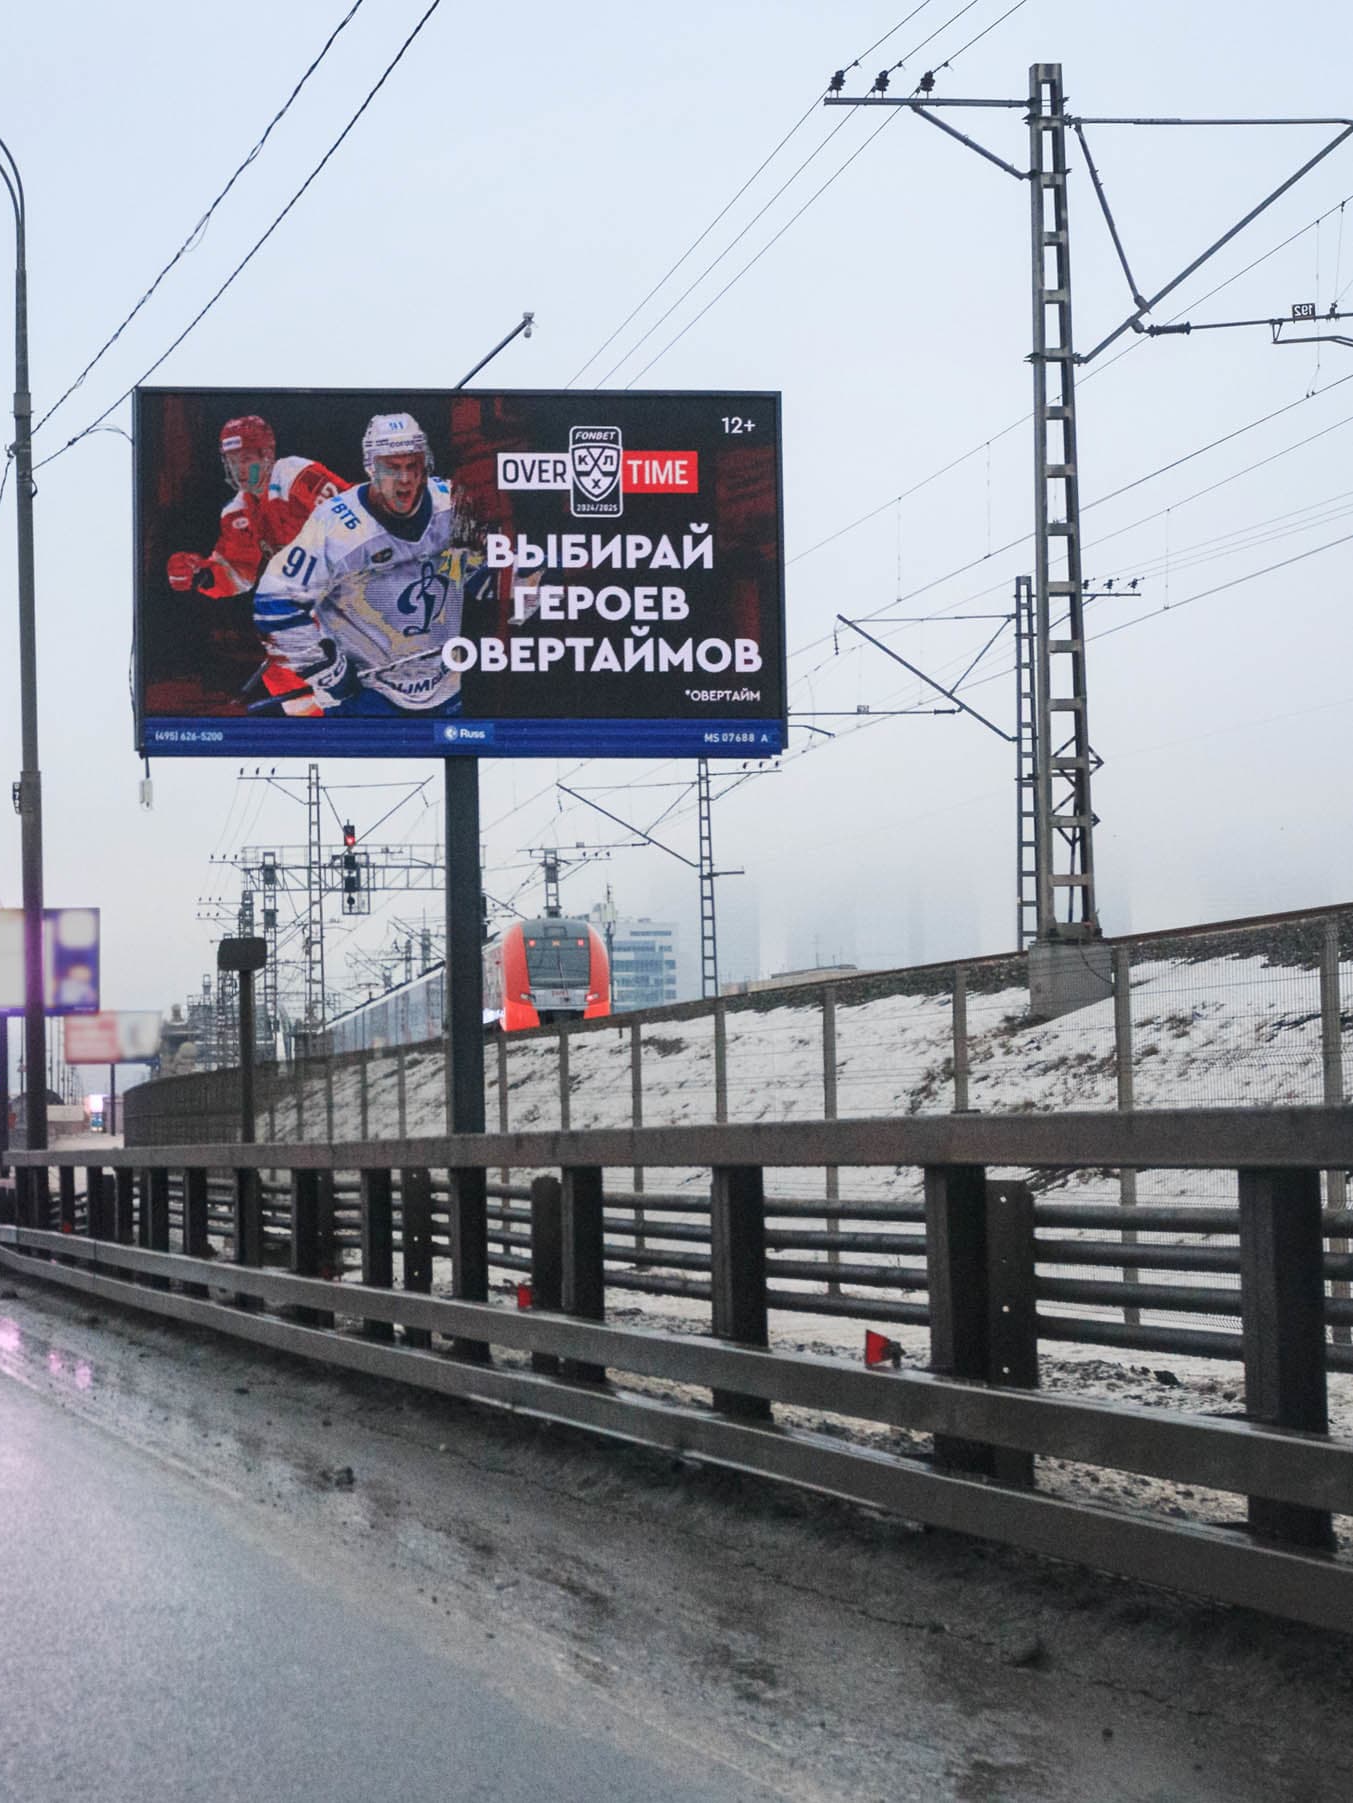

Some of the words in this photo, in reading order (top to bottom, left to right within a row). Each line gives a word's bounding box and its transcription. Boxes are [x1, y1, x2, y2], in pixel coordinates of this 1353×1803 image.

[575, 431, 616, 441] FONBET
[721, 416, 756, 434] 12+
[502, 459, 567, 484] OVER
[627, 460, 688, 485] TIME
[331, 503, 361, 530] ВТБ
[576, 503, 618, 512] 2024/2025
[486, 522, 713, 569] ВЫБИРАЙ
[282, 546, 317, 586] 91
[514, 586, 690, 621] ГЕРОЕВ
[441, 625, 763, 673] ОВЕРТАЙМОВ
[155, 730, 178, 741] (495)
[180, 731, 224, 741] 626-5200
[460, 728, 485, 739] Russ
[704, 733, 719, 742] MS
[761, 734, 768, 742] A
